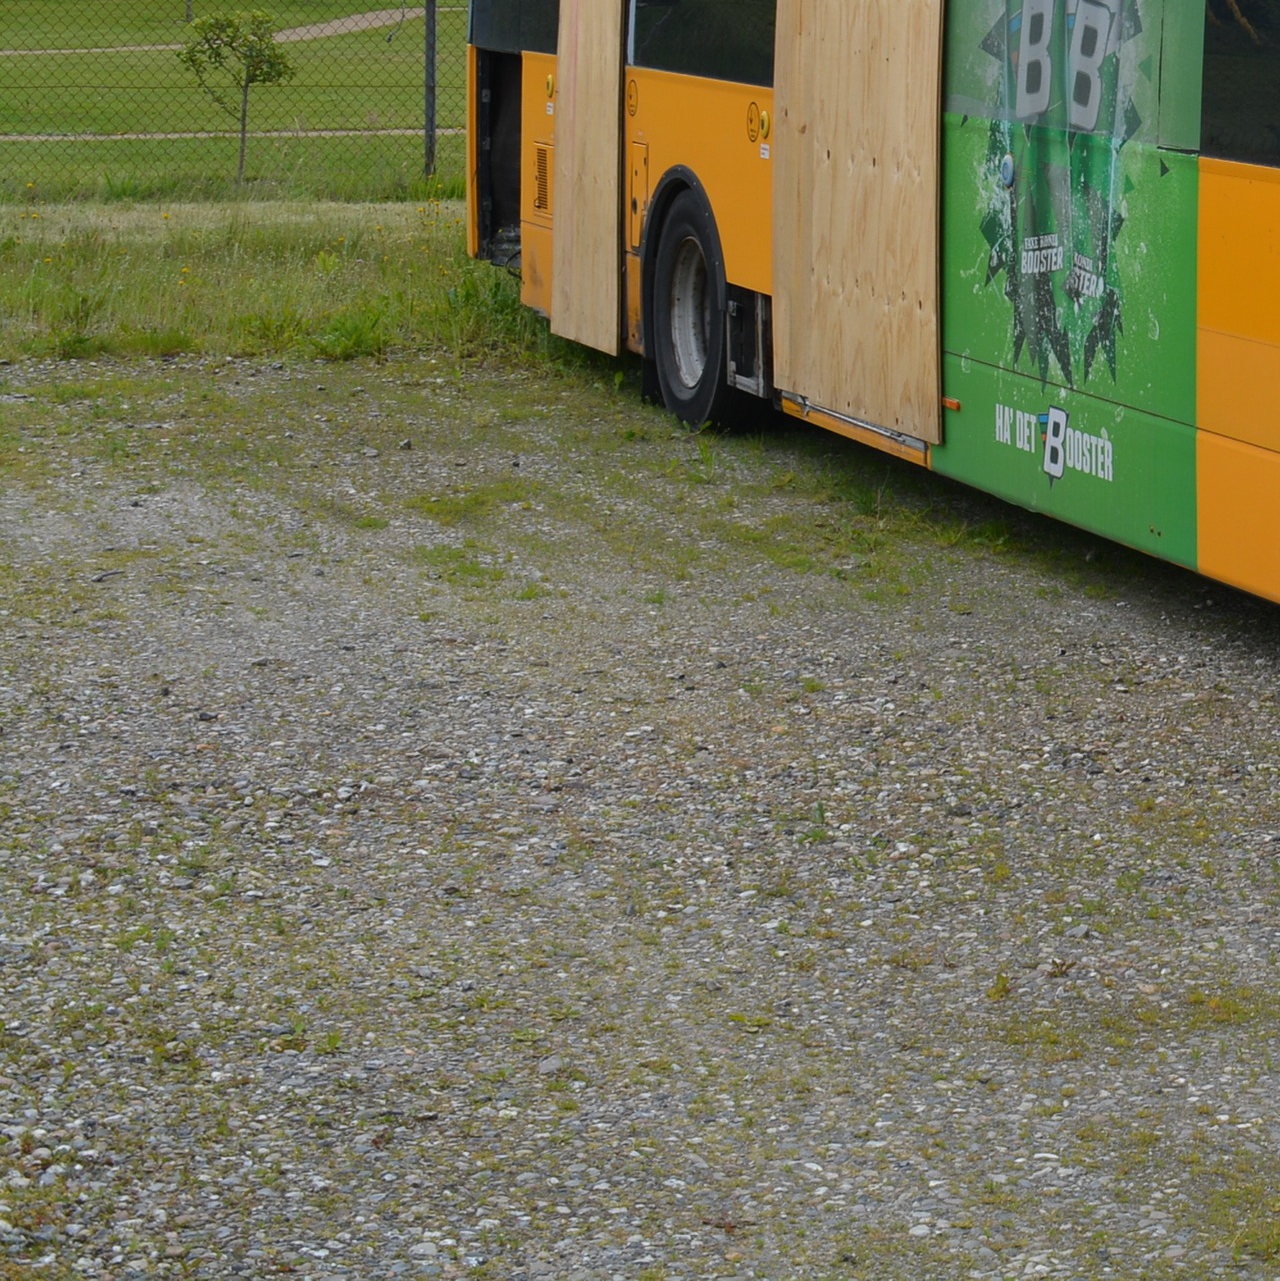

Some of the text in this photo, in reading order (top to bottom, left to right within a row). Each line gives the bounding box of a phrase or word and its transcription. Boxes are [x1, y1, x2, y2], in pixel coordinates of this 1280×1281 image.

[1021, 246, 1063, 274] BOOSTER
[995, 403, 1114, 482] HA' DET BOOSTER
